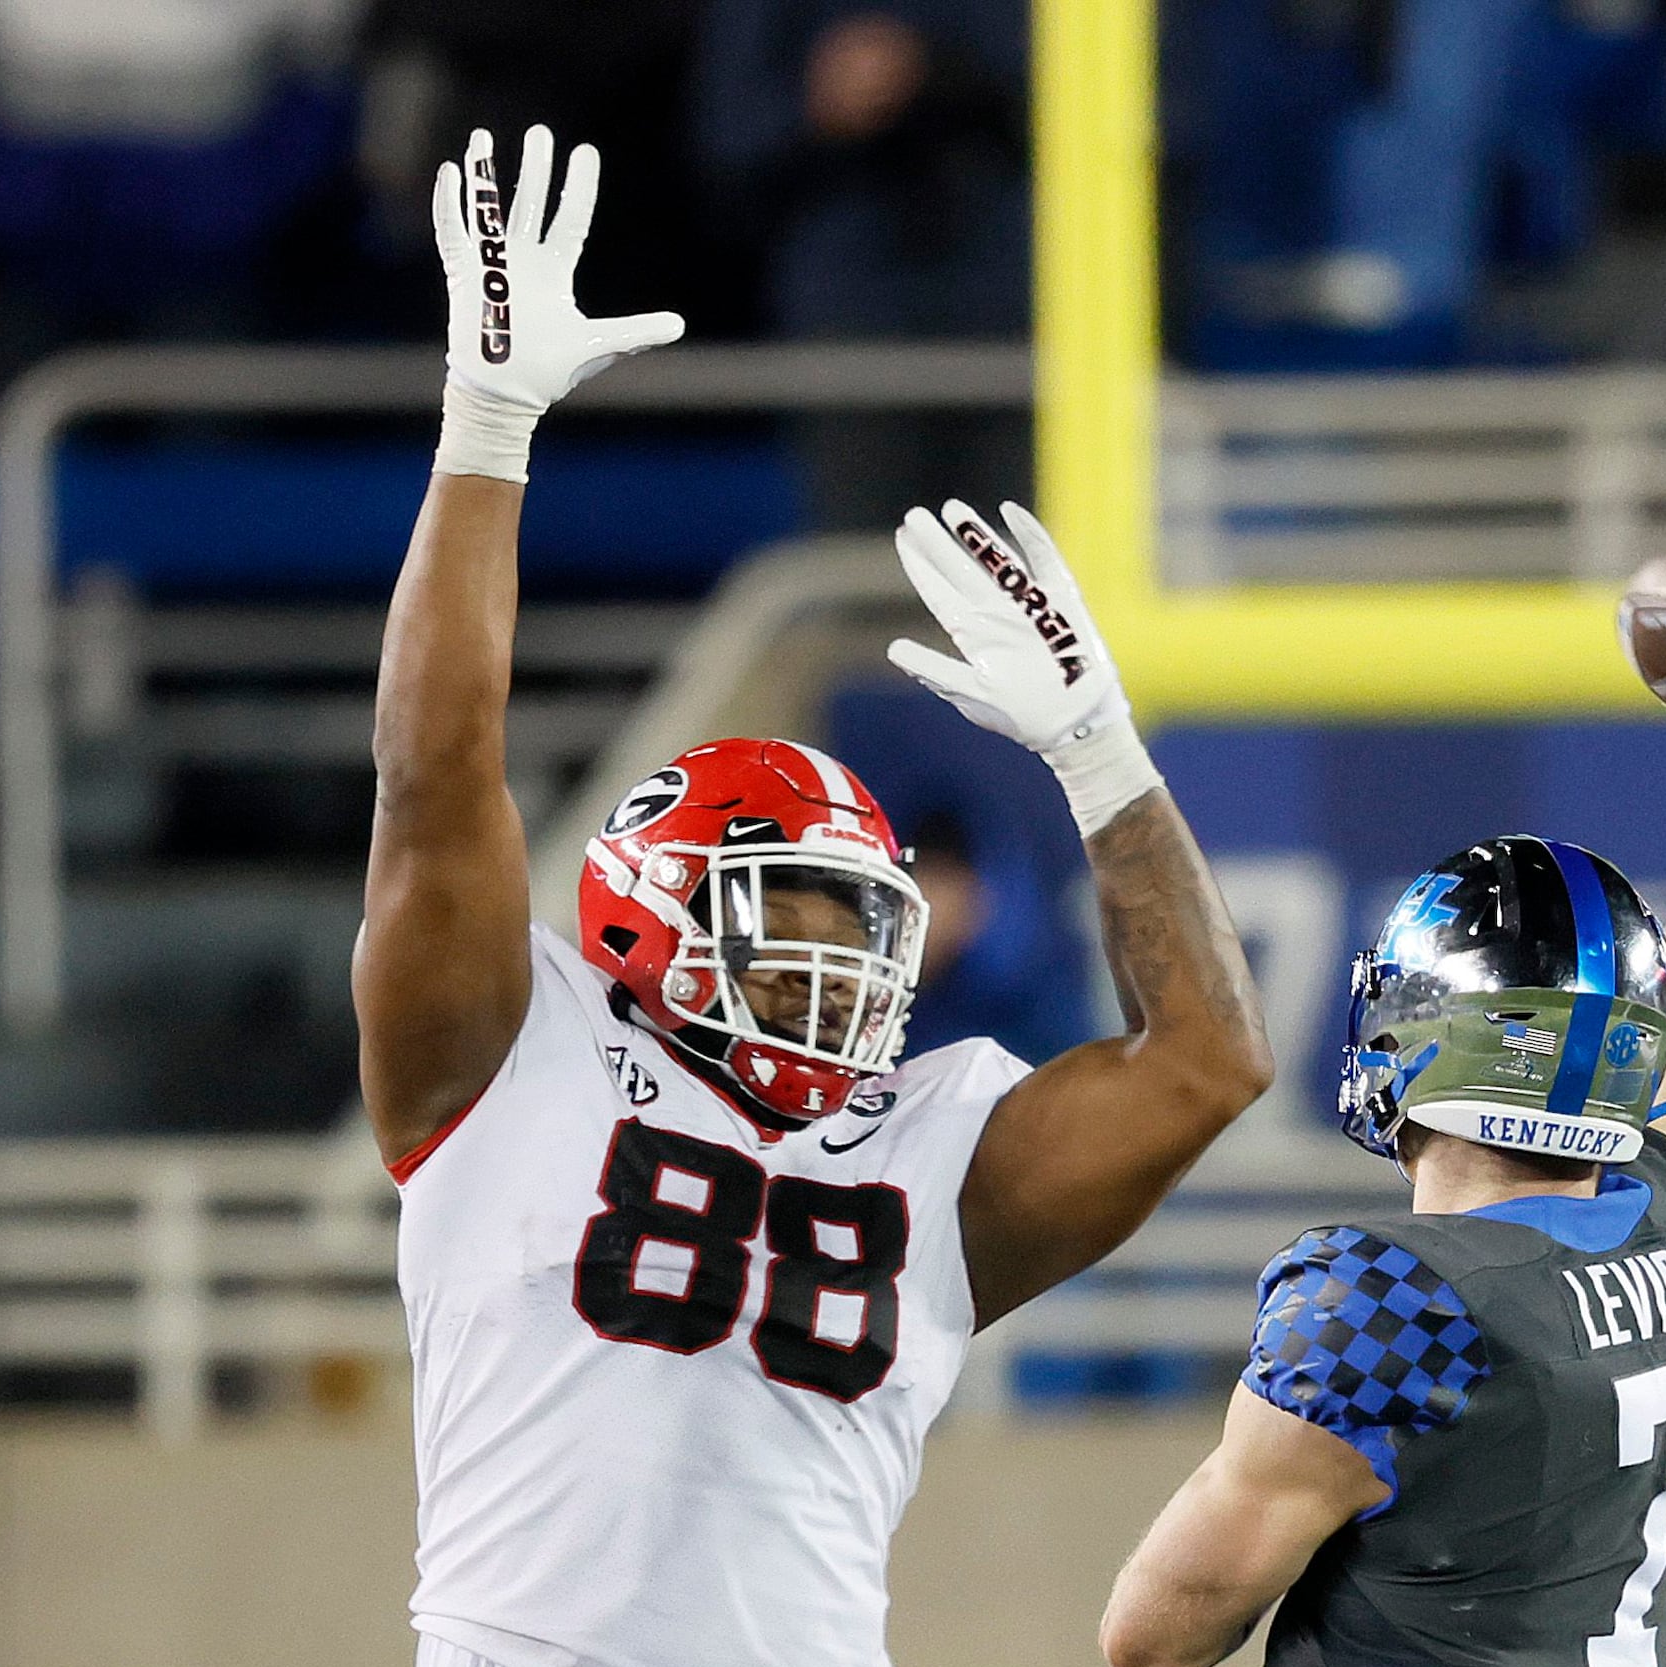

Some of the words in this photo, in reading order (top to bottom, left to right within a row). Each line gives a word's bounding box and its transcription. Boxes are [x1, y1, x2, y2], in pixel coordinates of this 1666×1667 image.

[467, 156, 512, 365] GEORGIA
[956, 520, 1087, 688] GEORGIA
[1478, 1114, 1627, 1157] KENTUCKY
[573, 1116, 909, 1404] 88
